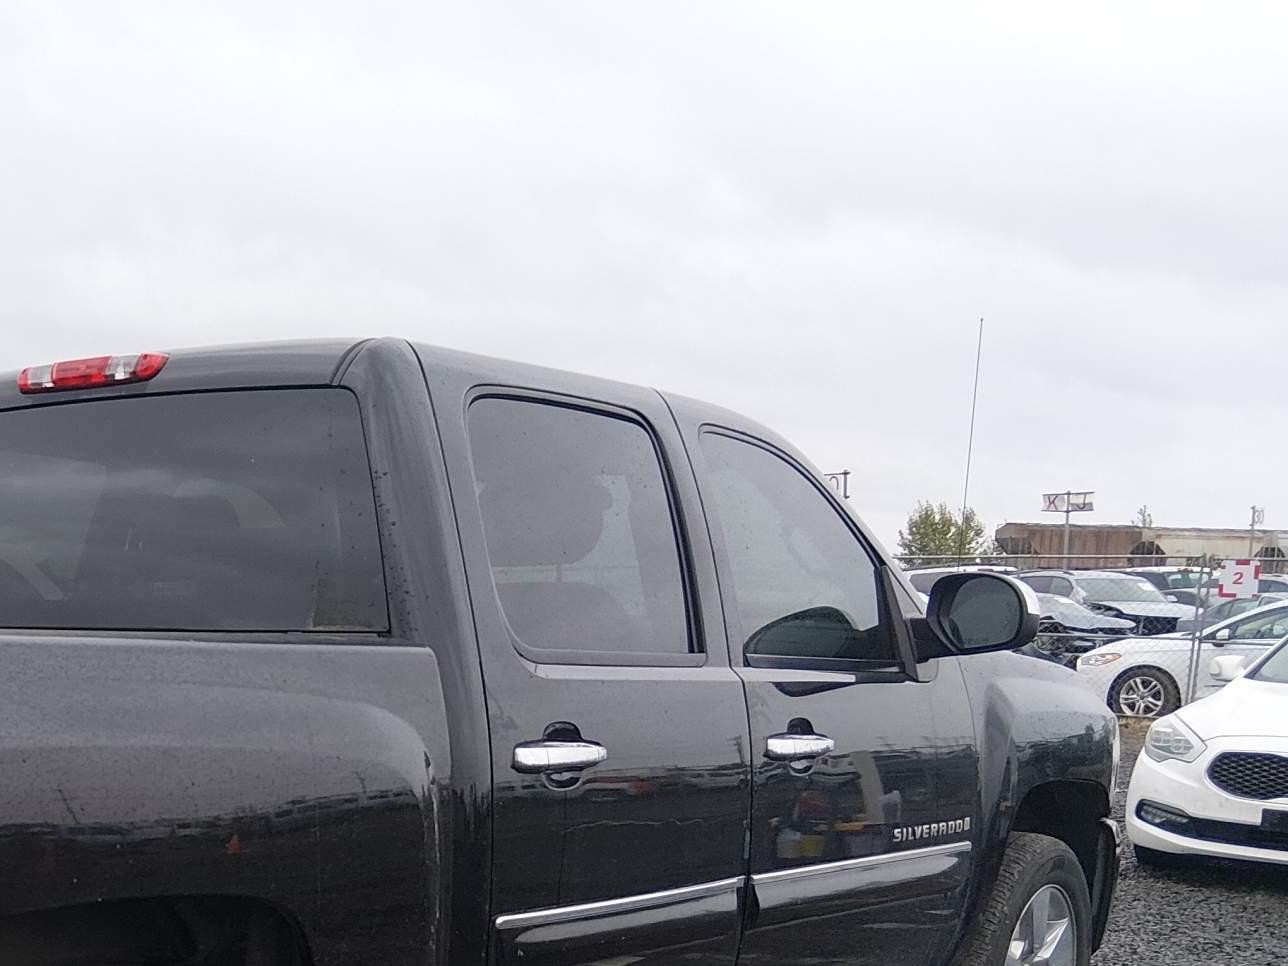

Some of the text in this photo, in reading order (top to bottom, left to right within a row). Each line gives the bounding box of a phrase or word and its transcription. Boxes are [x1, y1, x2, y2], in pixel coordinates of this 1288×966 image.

[1046, 495, 1058, 510] K
[1232, 571, 1244, 585] 2
[893, 819, 963, 842] SILVERADO
